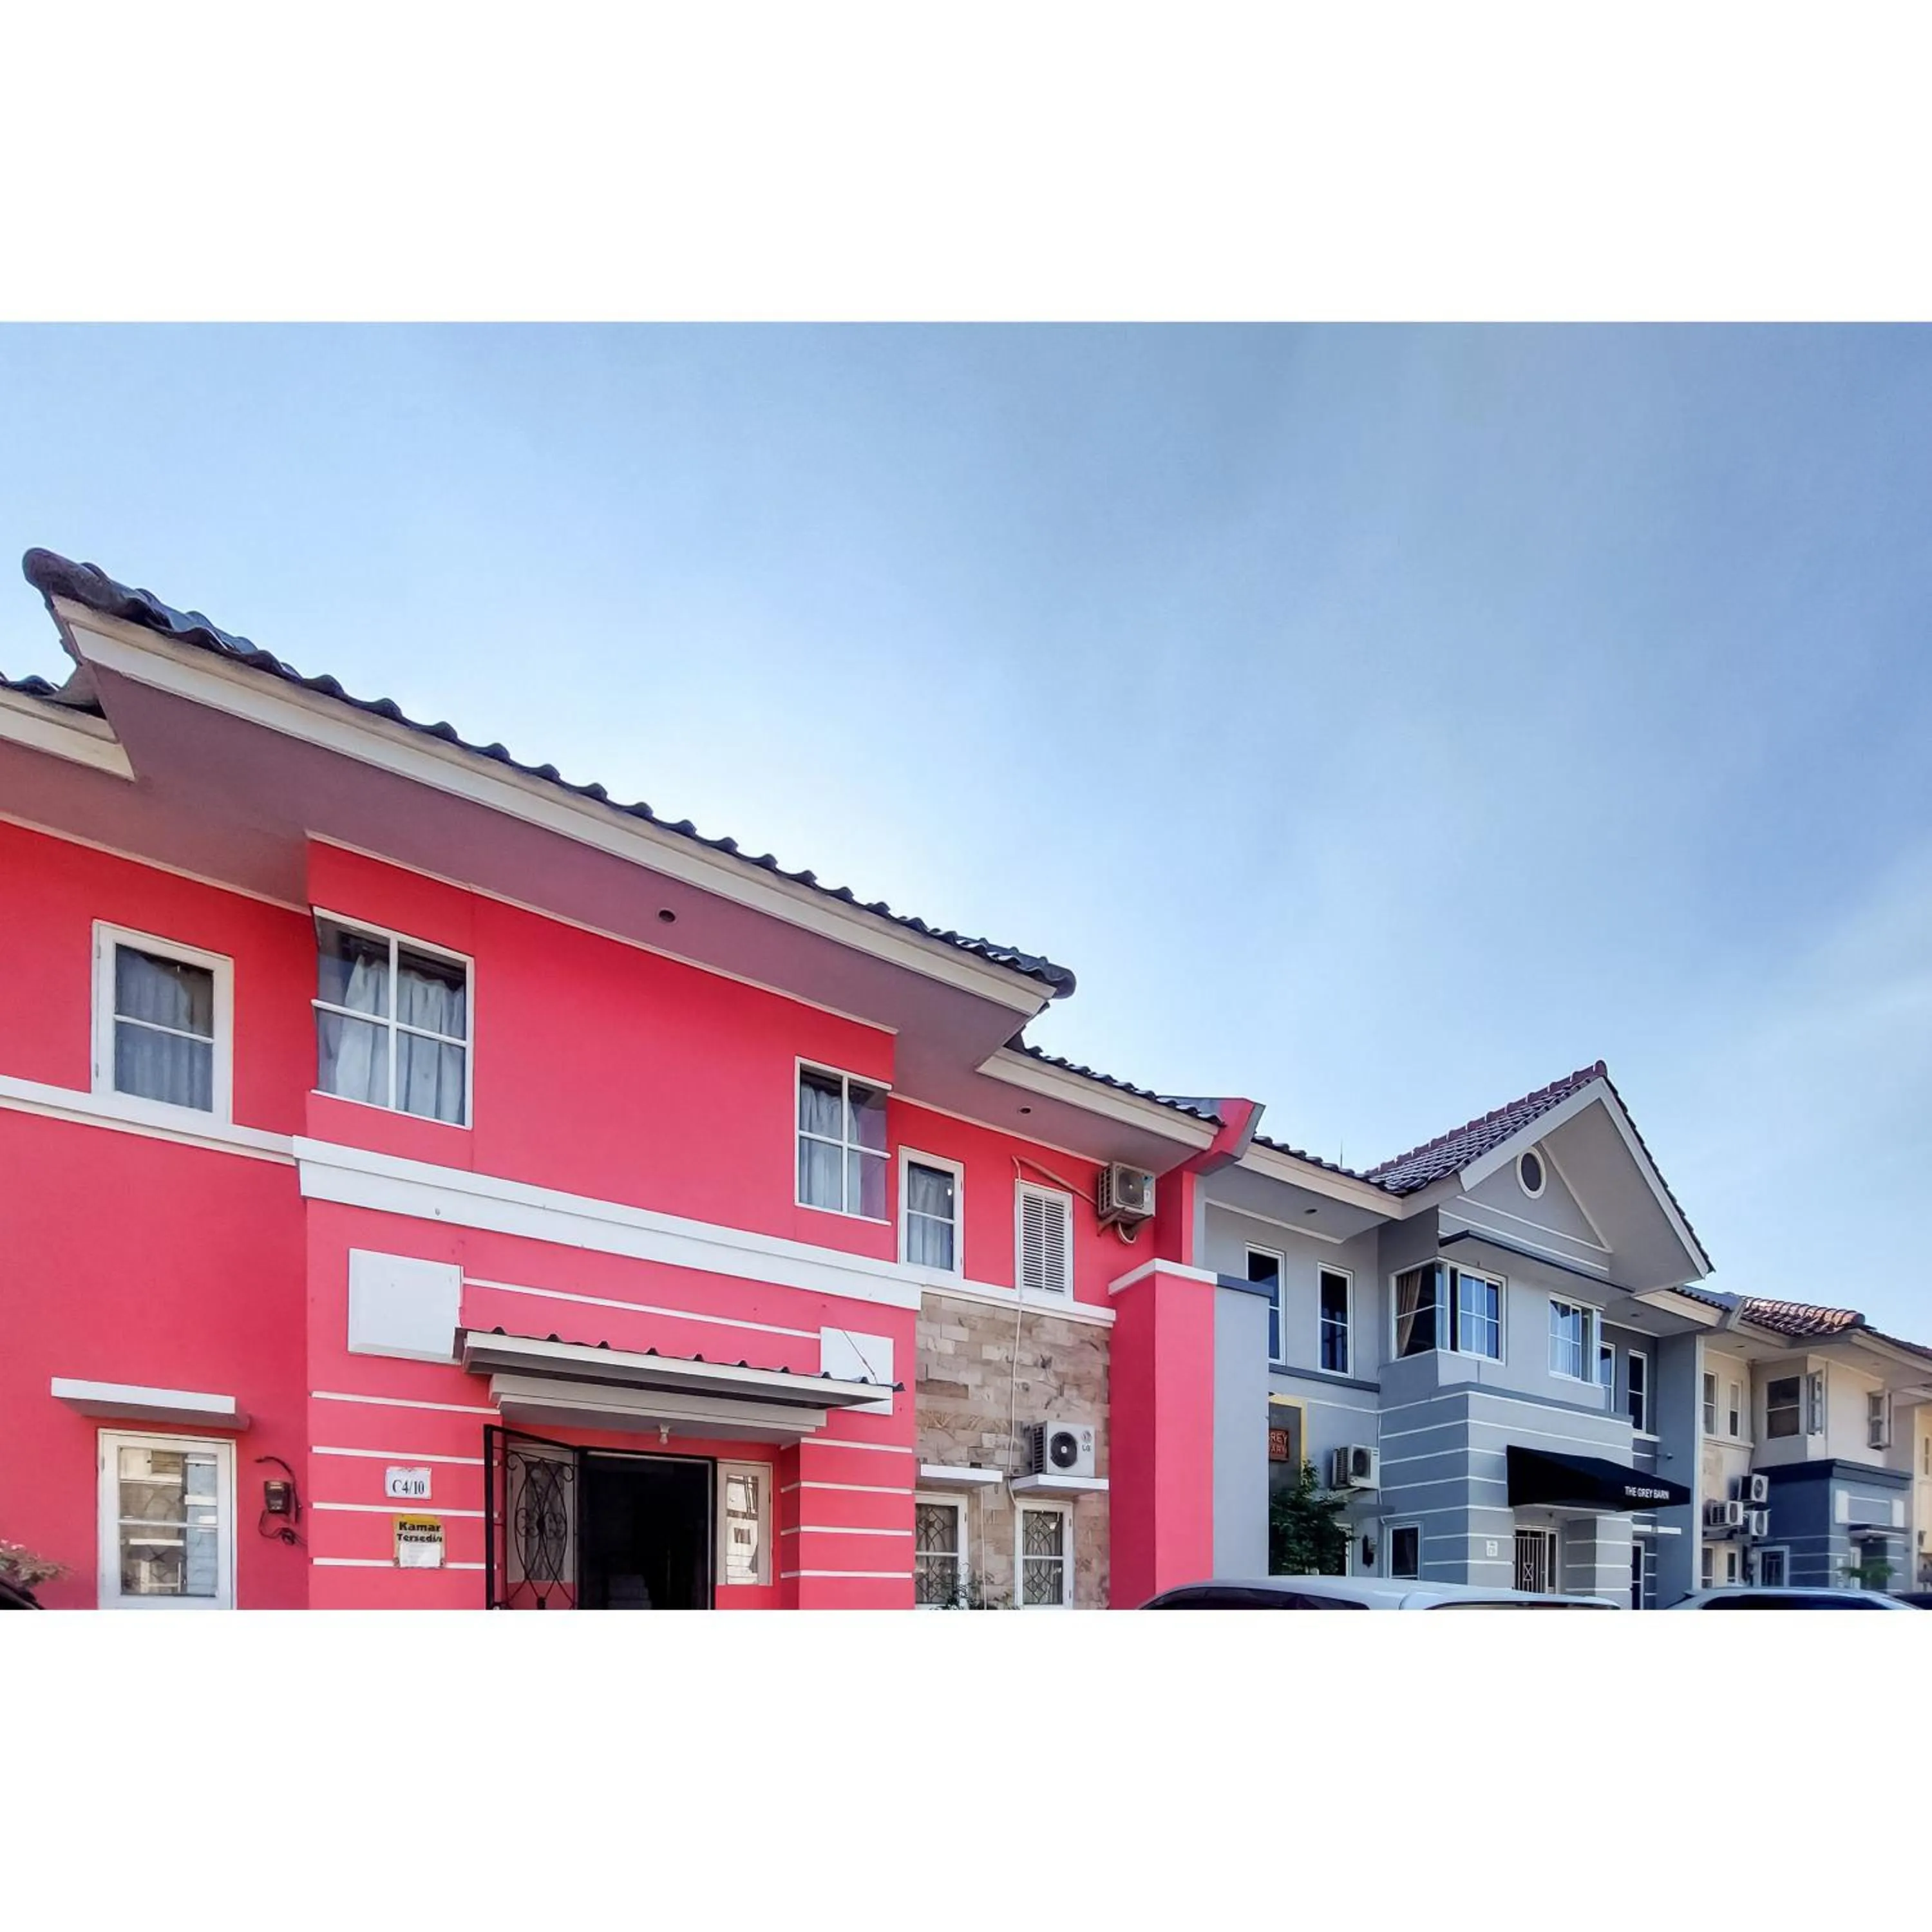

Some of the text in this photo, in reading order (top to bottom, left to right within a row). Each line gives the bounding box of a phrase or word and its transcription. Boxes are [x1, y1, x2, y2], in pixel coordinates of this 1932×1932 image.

[1269, 1432, 1287, 1445] REY
[392, 1479, 424, 1495] C4/10
[1624, 1486, 1669, 1500] THE GREY BARN
[399, 1521, 440, 1532] Kamar
